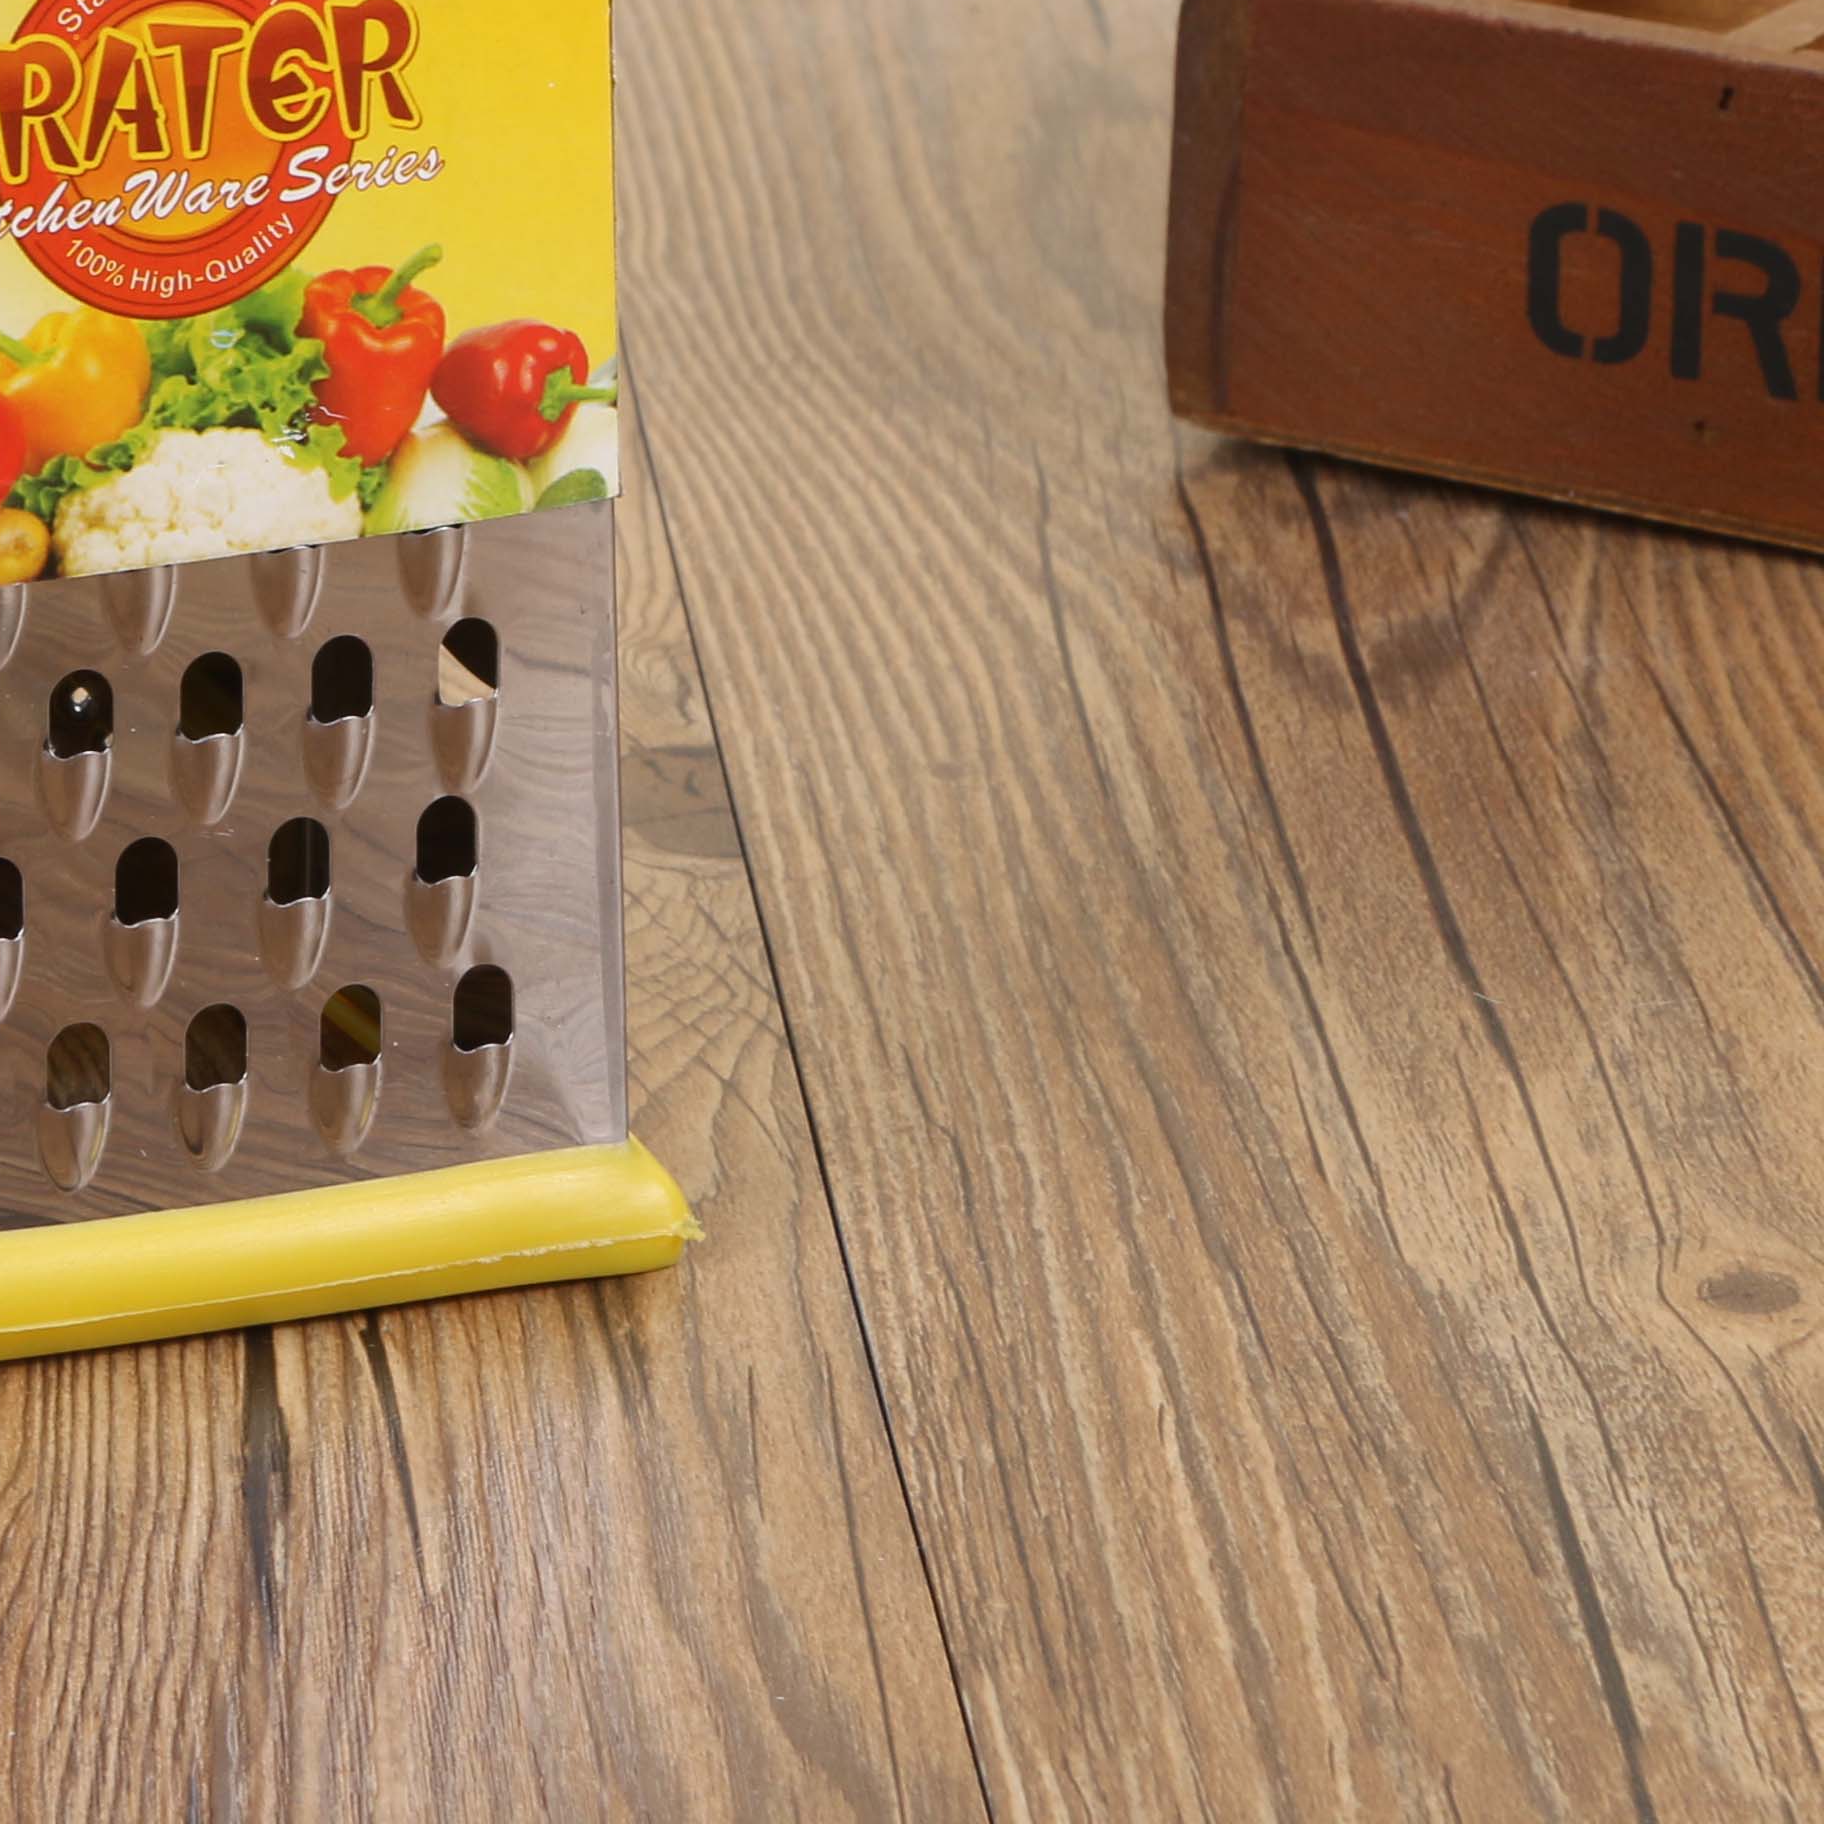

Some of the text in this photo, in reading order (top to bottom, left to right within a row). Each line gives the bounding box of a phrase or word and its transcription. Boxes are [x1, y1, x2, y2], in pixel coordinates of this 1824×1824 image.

[278, 144, 445, 203] Series
[66, 212, 295, 299] 100% High-Quality
[1527, 201, 1824, 402] OR
